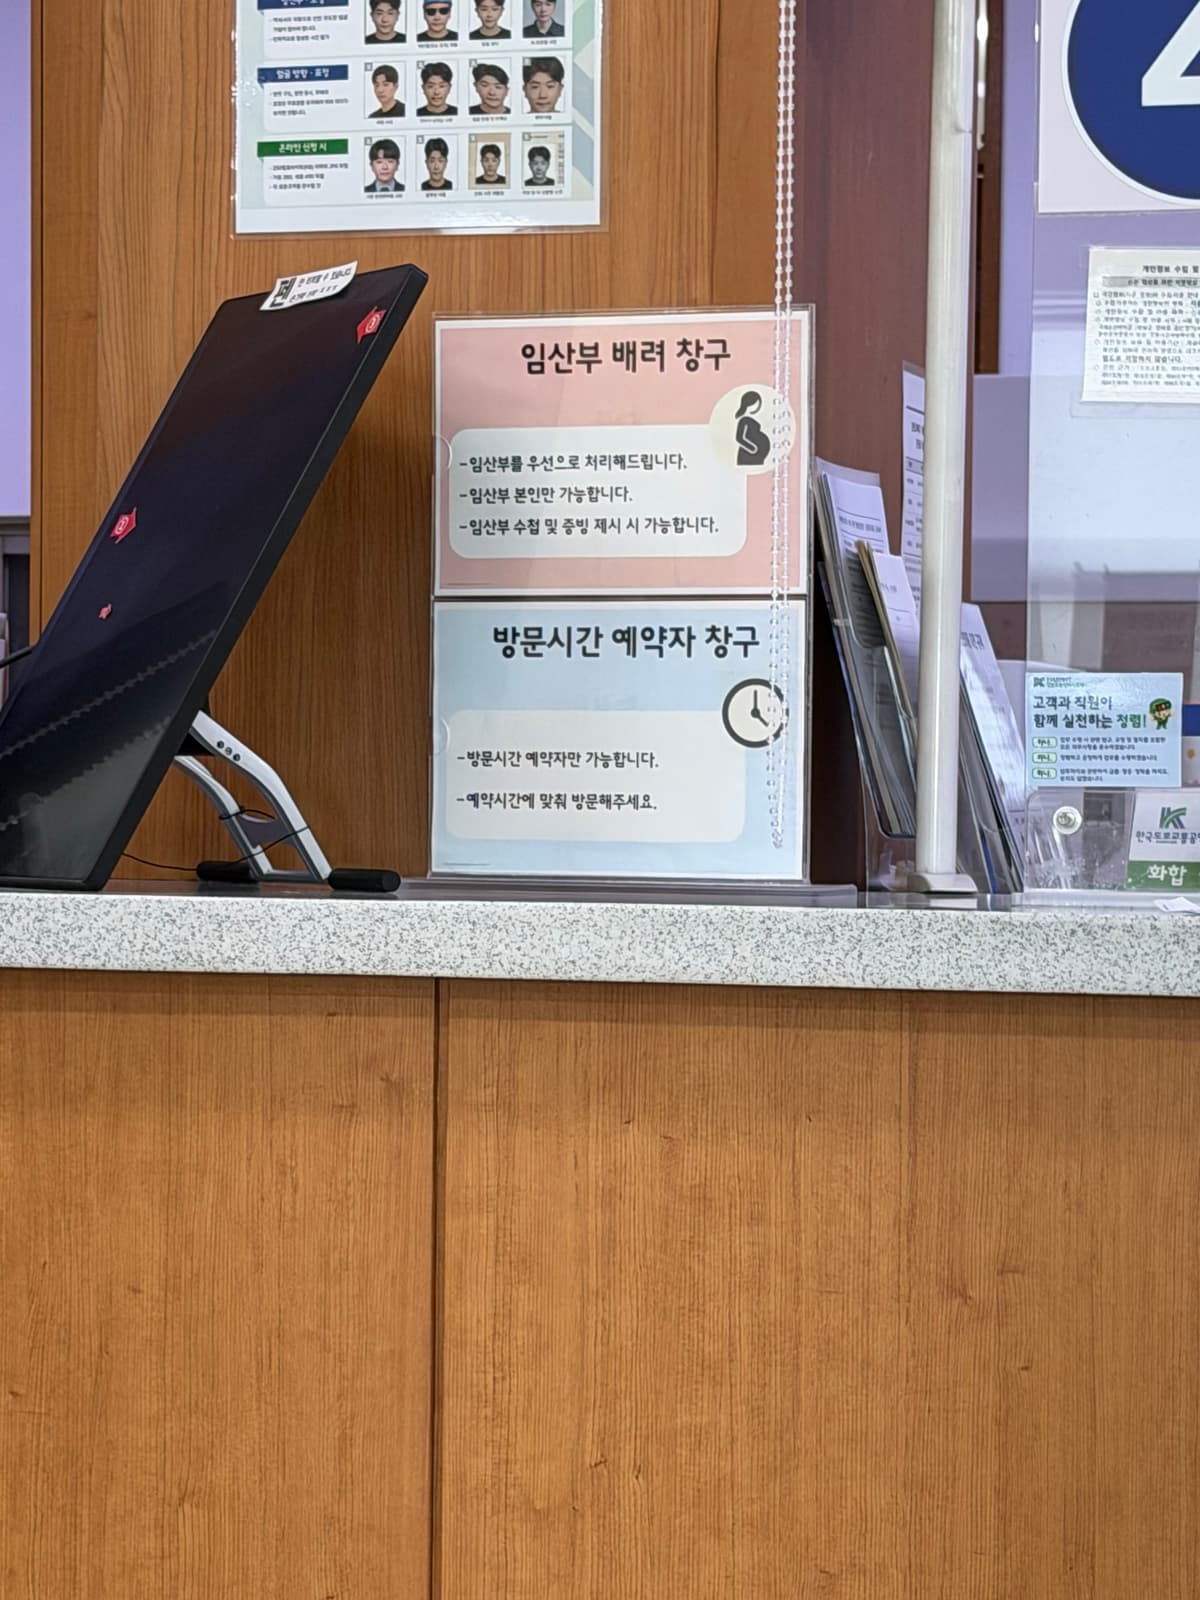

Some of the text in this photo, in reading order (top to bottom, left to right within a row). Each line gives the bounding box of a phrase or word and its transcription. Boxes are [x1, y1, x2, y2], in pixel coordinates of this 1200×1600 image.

[522, 338, 730, 374] 임산부 배려 창구
[459, 454, 686, 473] -임산부를 우선으로 처리해드립니다.
[459, 486, 632, 504] -임산부 본인만 가능합니다.
[459, 517, 718, 536] -임산부 수첩 및 증빙 제시 시 가능합니다.
[494, 625, 759, 658] 방문시간 예약자 창구
[1033, 696, 1112, 711] 고객과 직원이
[1034, 714, 1146, 729] 함께 실천하는 청렴!
[457, 751, 658, 768] -방문시간 예약자만 가능합니다.
[456, 793, 656, 810] -예약시간에 맞춰 방문해주세요.
[1136, 831, 1200, 844] 한국도로교통공
[1147, 864, 1187, 886] 화합
